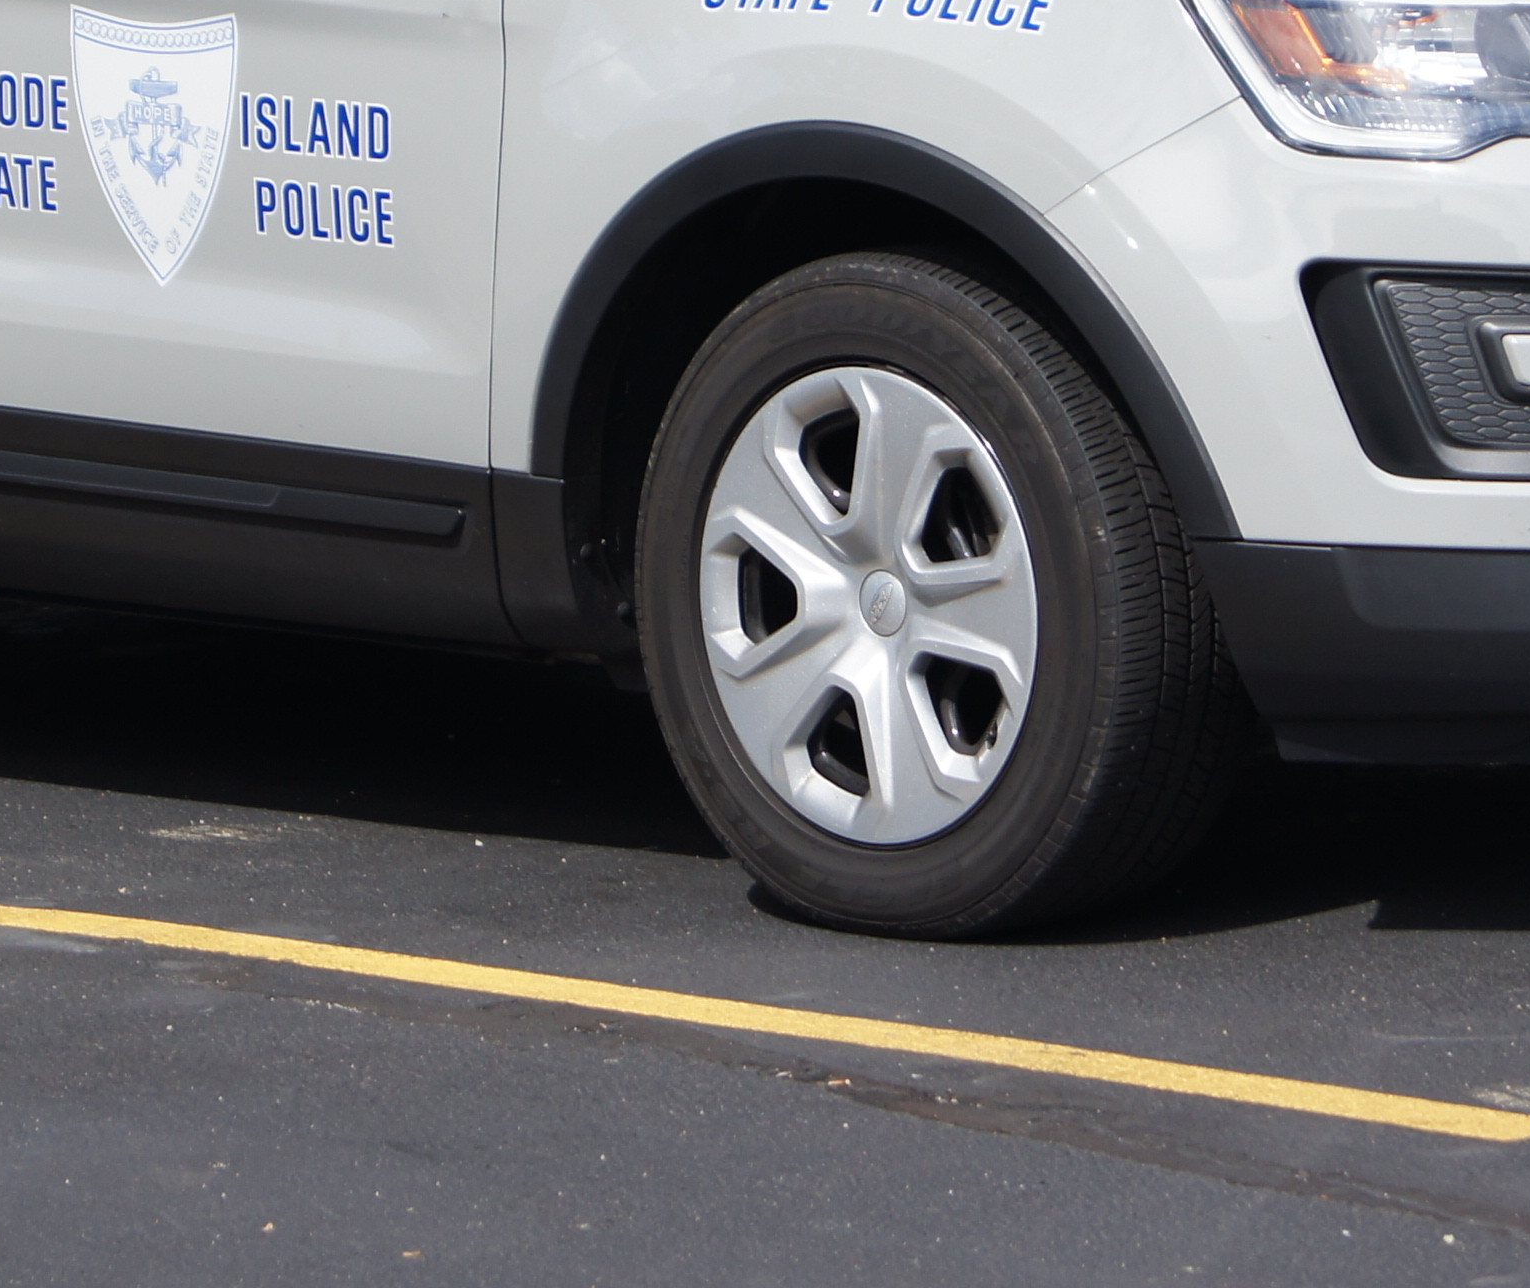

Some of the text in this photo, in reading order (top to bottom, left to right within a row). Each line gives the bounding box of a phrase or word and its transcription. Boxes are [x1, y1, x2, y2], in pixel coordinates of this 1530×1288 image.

[134, 105, 172, 122] HOPE
[239, 91, 391, 162] ISLAND
[90, 116, 105, 138] IN
[99, 142, 120, 182] THE
[165, 227, 182, 255] OF
[179, 191, 202, 227] THE
[195, 126, 219, 189] STATE
[253, 177, 395, 248] POLICE
